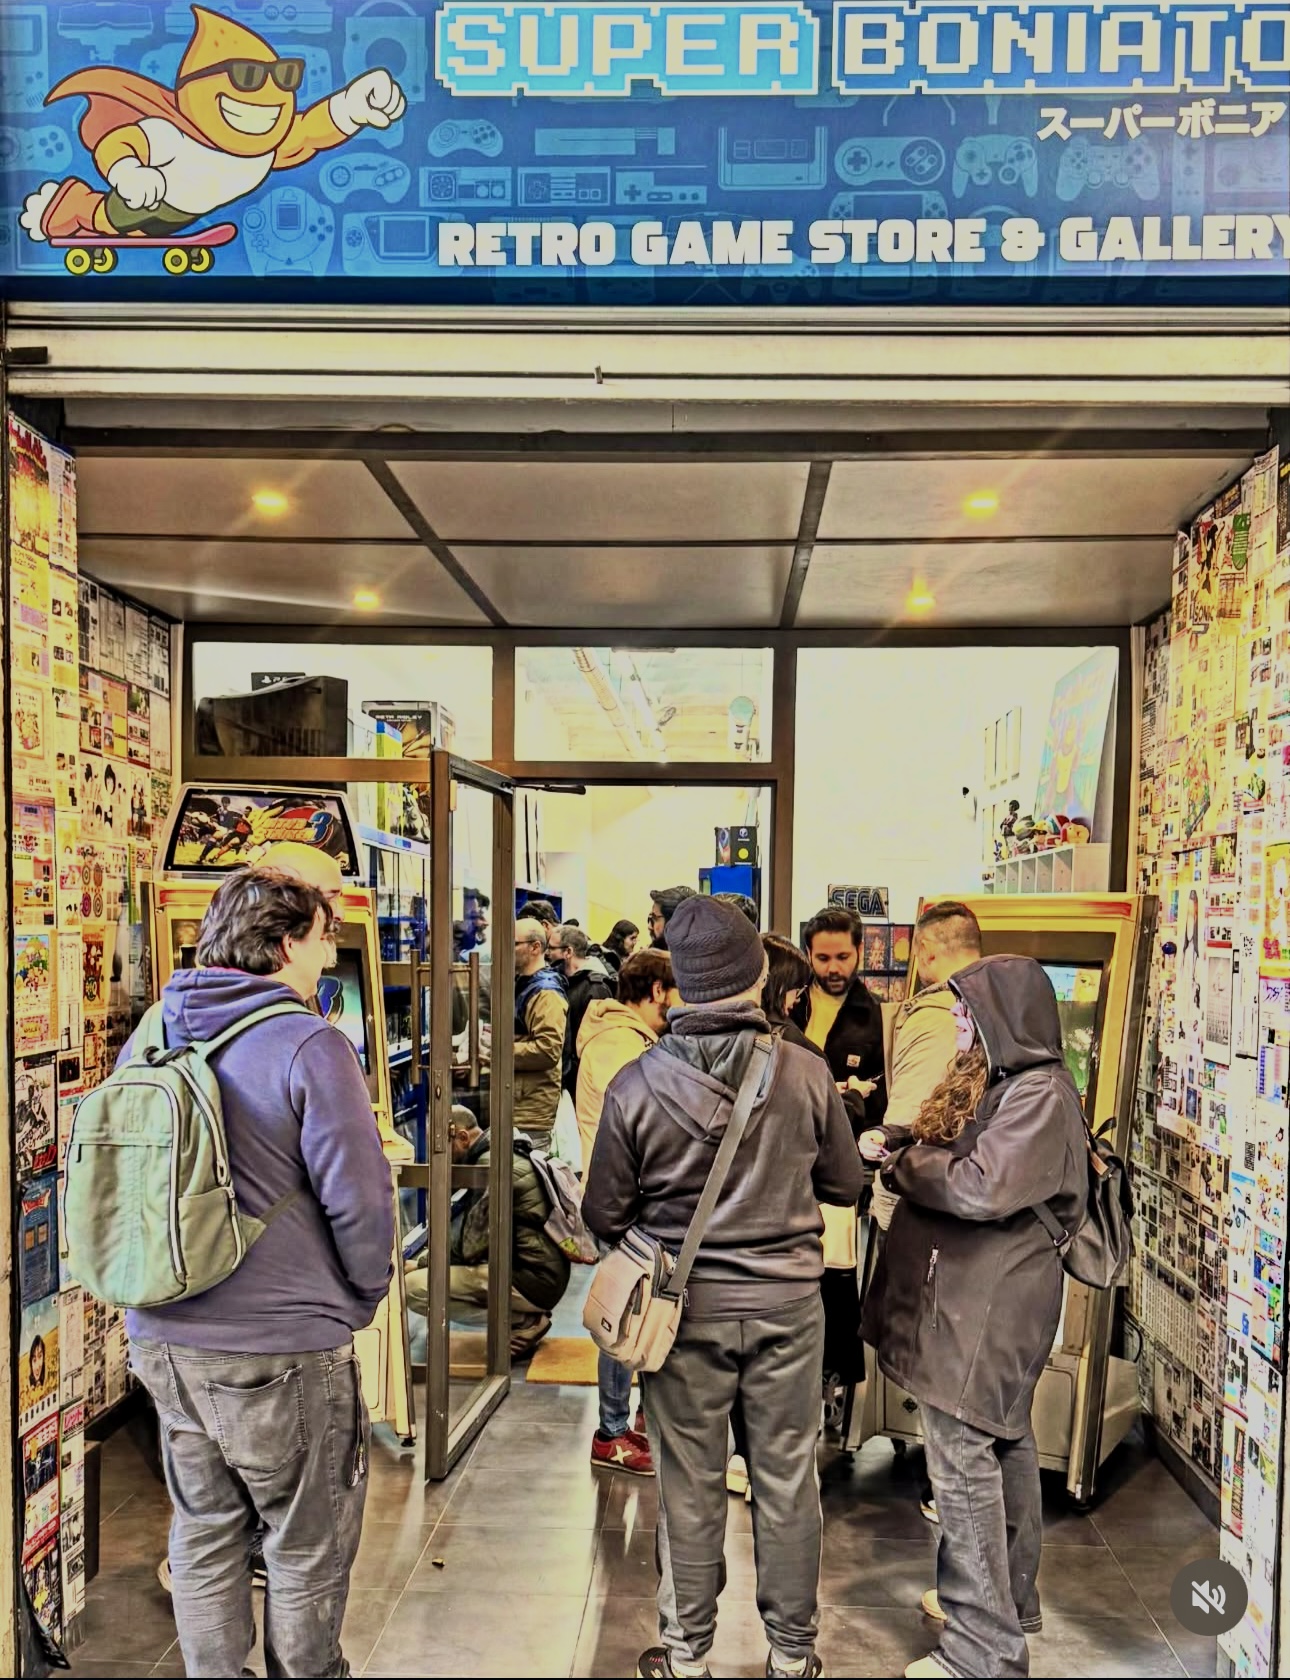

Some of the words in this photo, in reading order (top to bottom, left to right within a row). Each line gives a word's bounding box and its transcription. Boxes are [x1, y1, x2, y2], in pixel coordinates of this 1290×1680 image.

[447, 13, 799, 76] SUPER
[844, 11, 1290, 75] BONIATO
[1038, 98, 1287, 140] スーパーボニア
[438, 221, 615, 267] RETRO
[631, 220, 794, 266] GAME
[808, 218, 986, 265] STORE
[1001, 218, 1045, 264] &
[832, 888, 885, 915] SEGA
